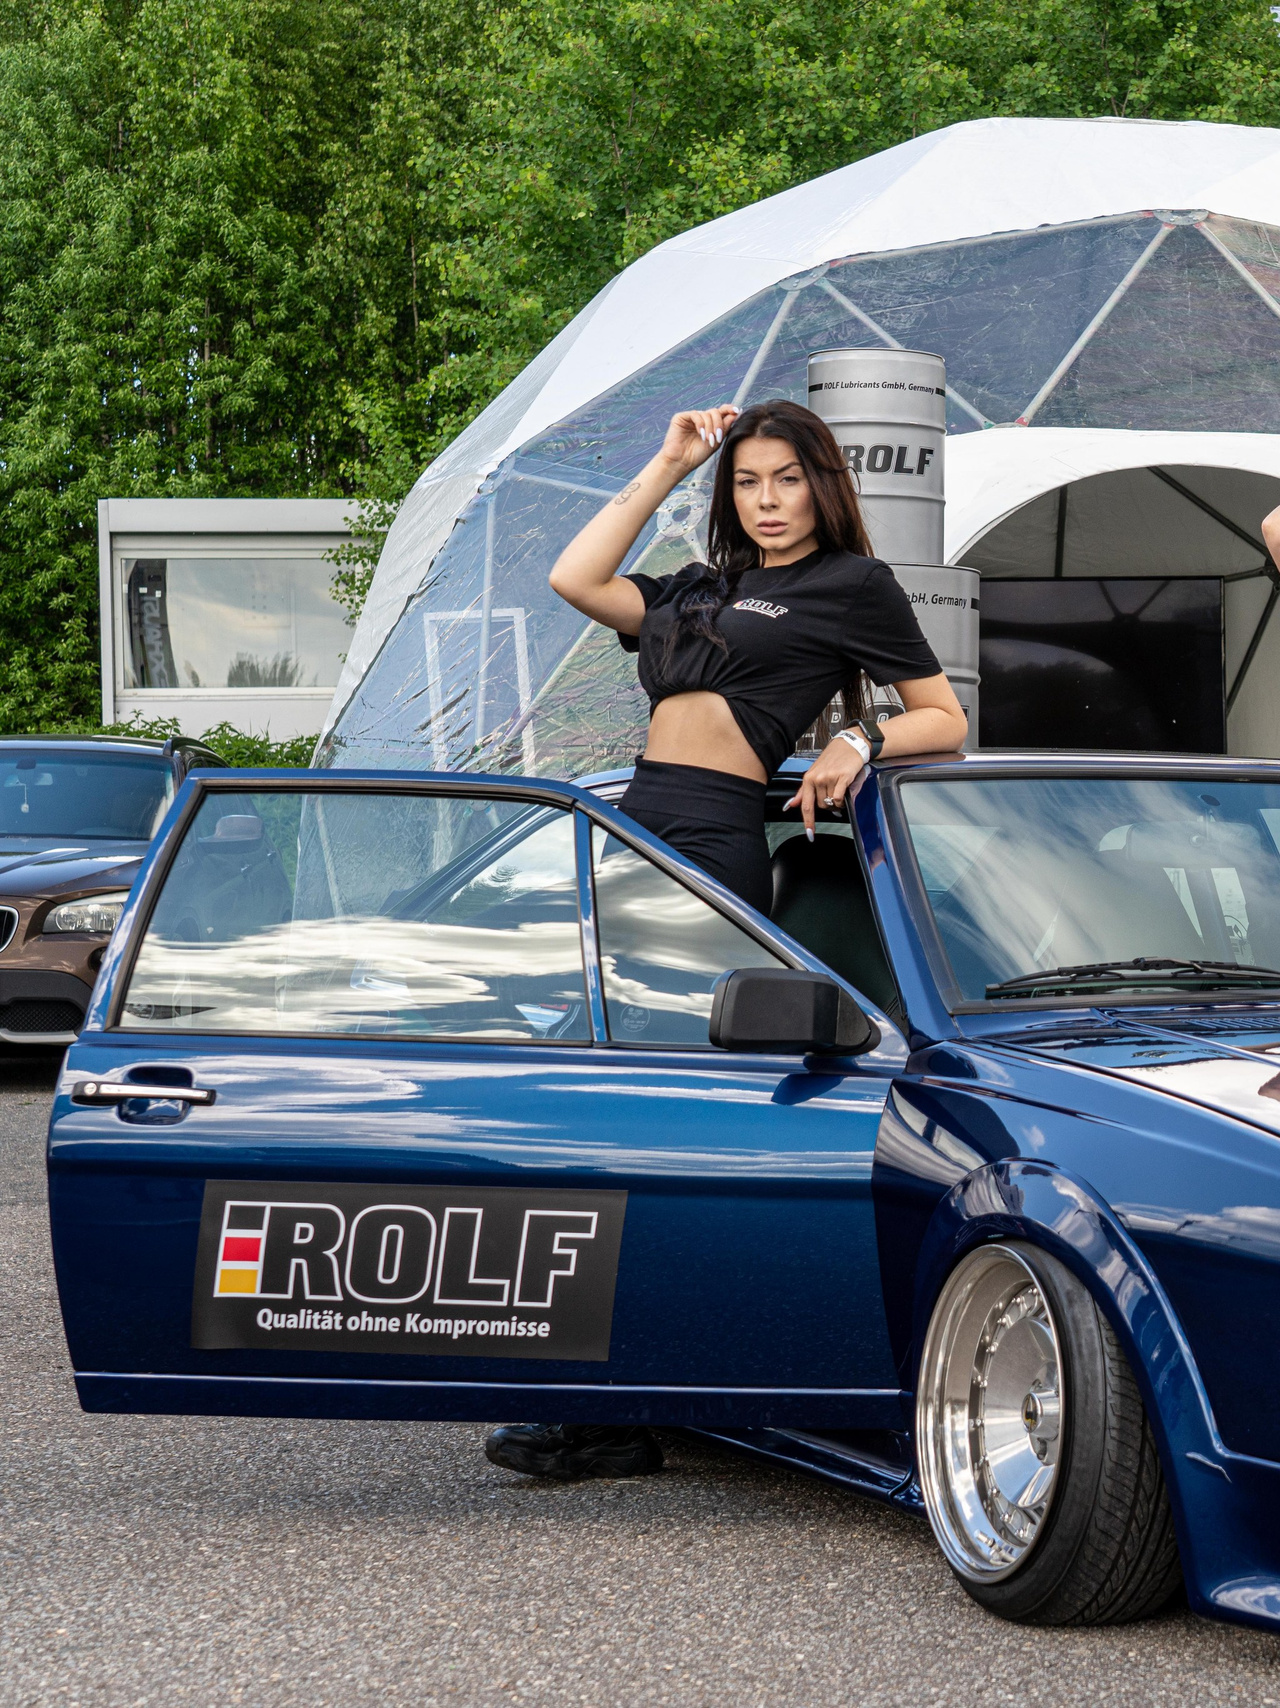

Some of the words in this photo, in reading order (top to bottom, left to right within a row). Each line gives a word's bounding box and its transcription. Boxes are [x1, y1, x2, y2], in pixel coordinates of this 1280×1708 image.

[824, 382, 840, 390] ROLF
[841, 381, 880, 389] Lubricants
[881, 381, 907, 391] GmbH,
[908, 383, 935, 395] Germany
[931, 593, 967, 609] Germany
[260, 1202, 598, 1307] ROLF
[256, 1307, 343, 1333] Qualität
[346, 1312, 400, 1333] ohne
[405, 1312, 551, 1339] Kompromisse
